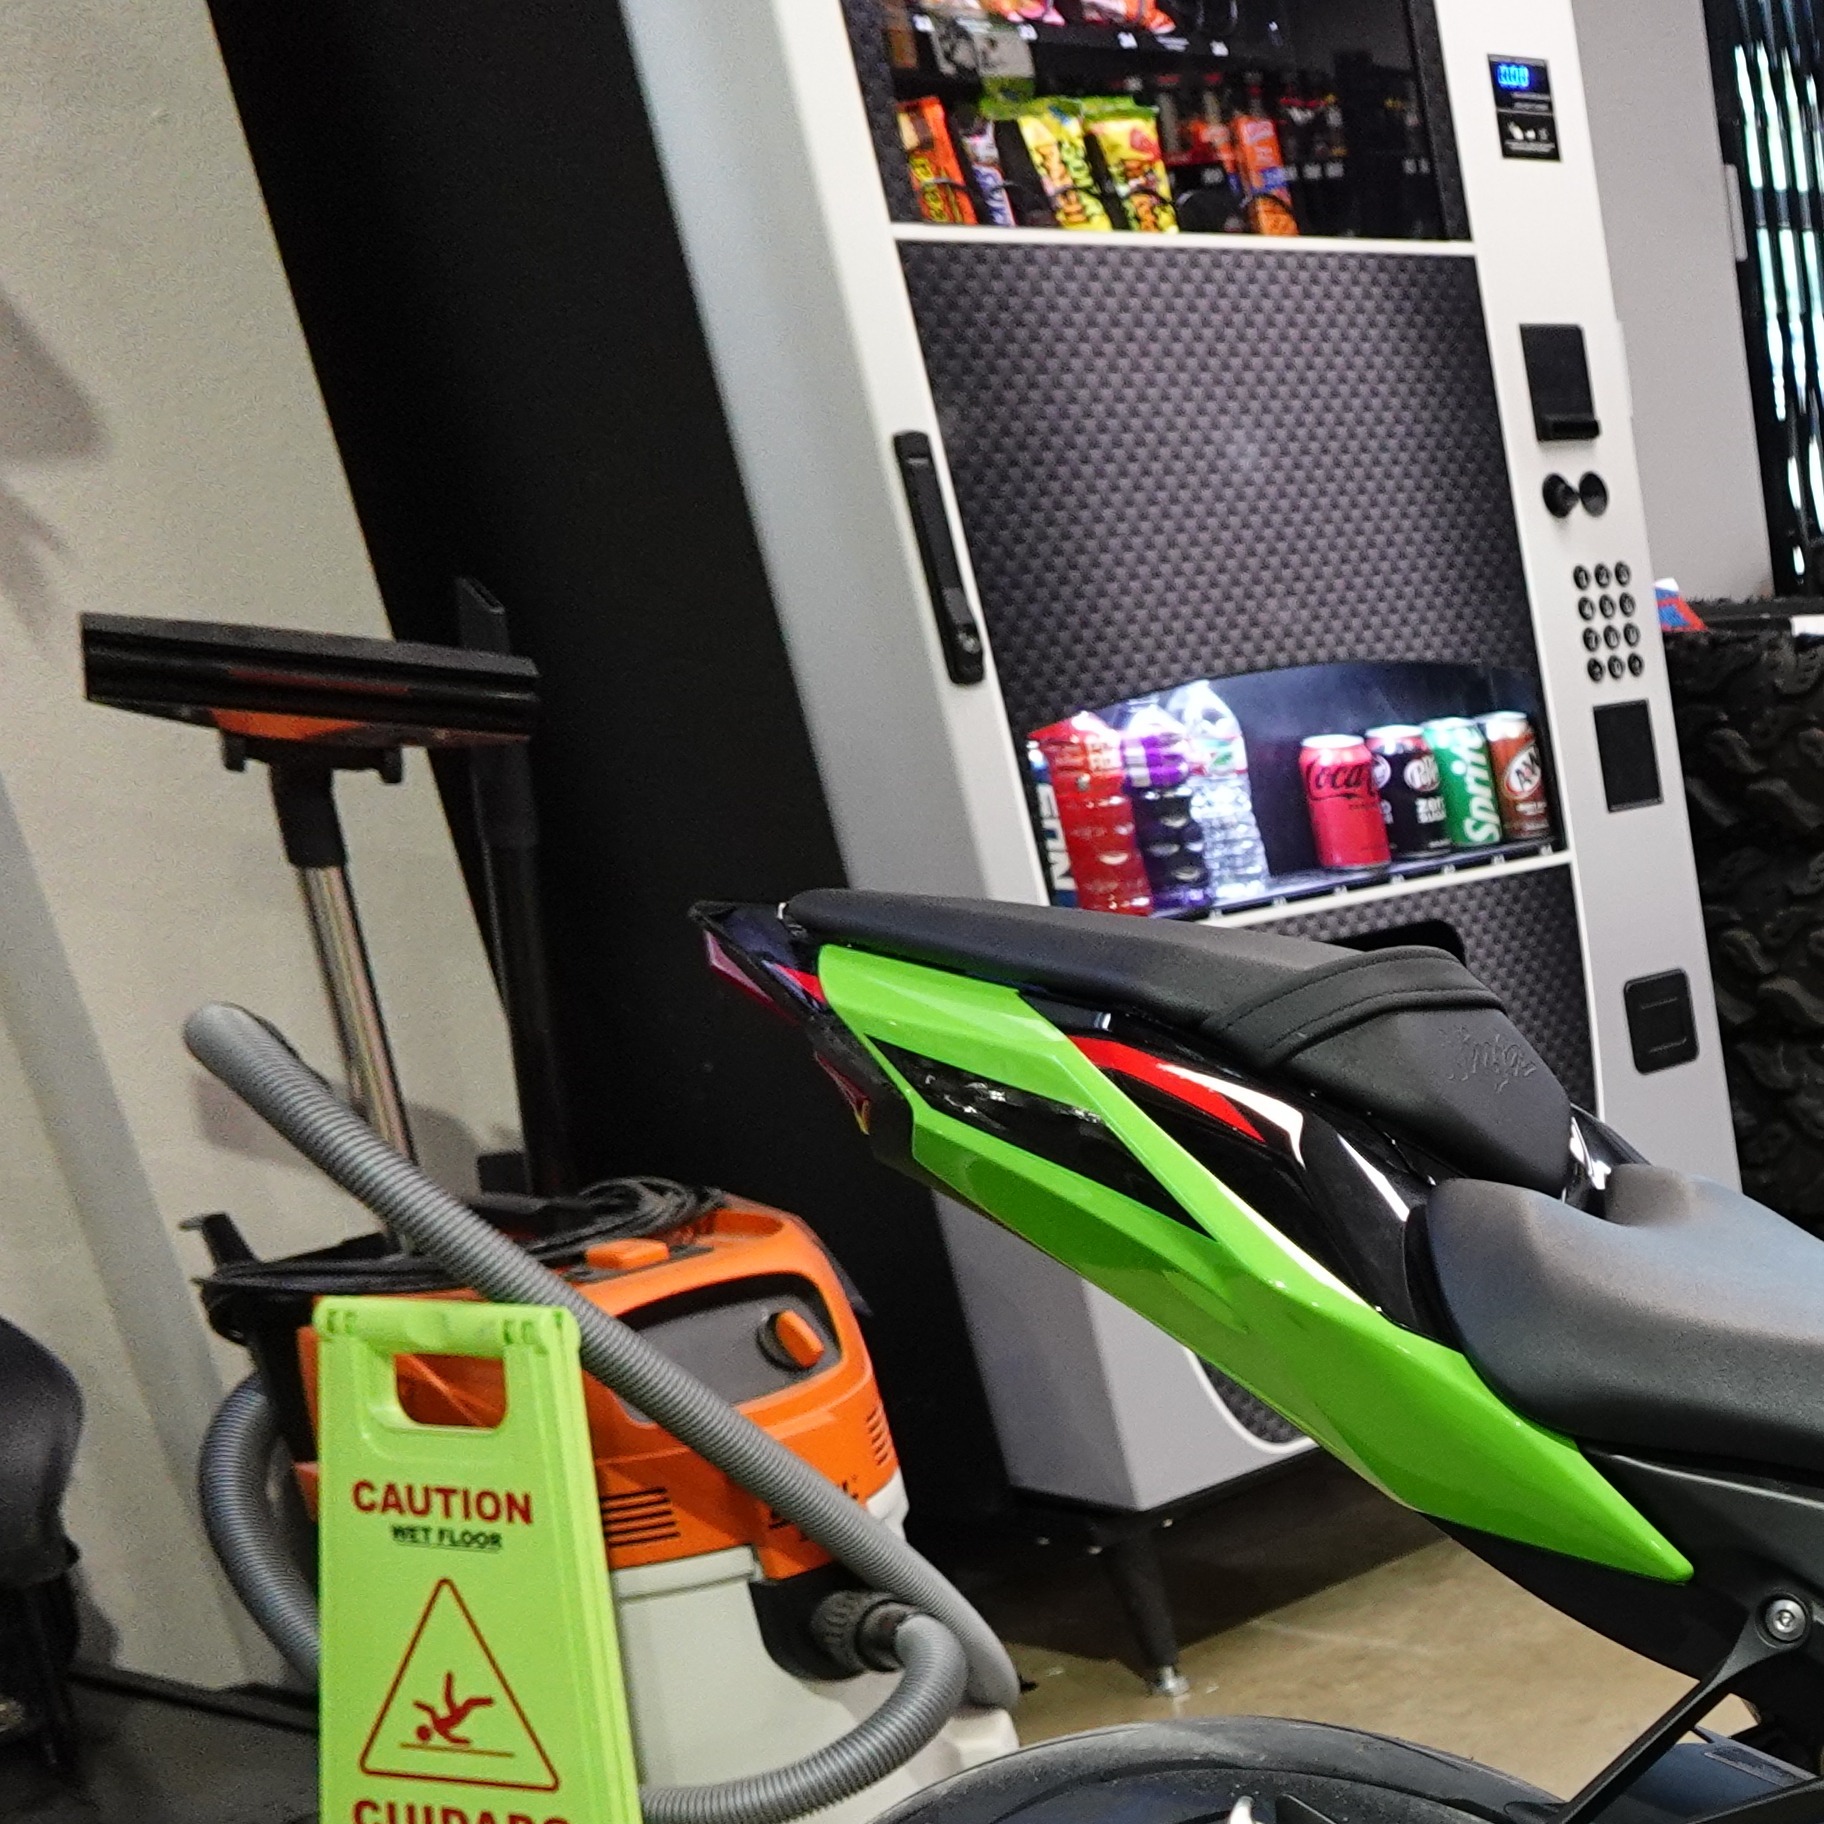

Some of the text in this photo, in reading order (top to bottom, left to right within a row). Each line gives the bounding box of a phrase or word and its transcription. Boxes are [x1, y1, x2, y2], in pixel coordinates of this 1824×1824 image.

[1450, 724, 1502, 845] Sprite
[351, 1478, 535, 1527] CAUTION
[389, 1522, 504, 1551] WET FLOOR
